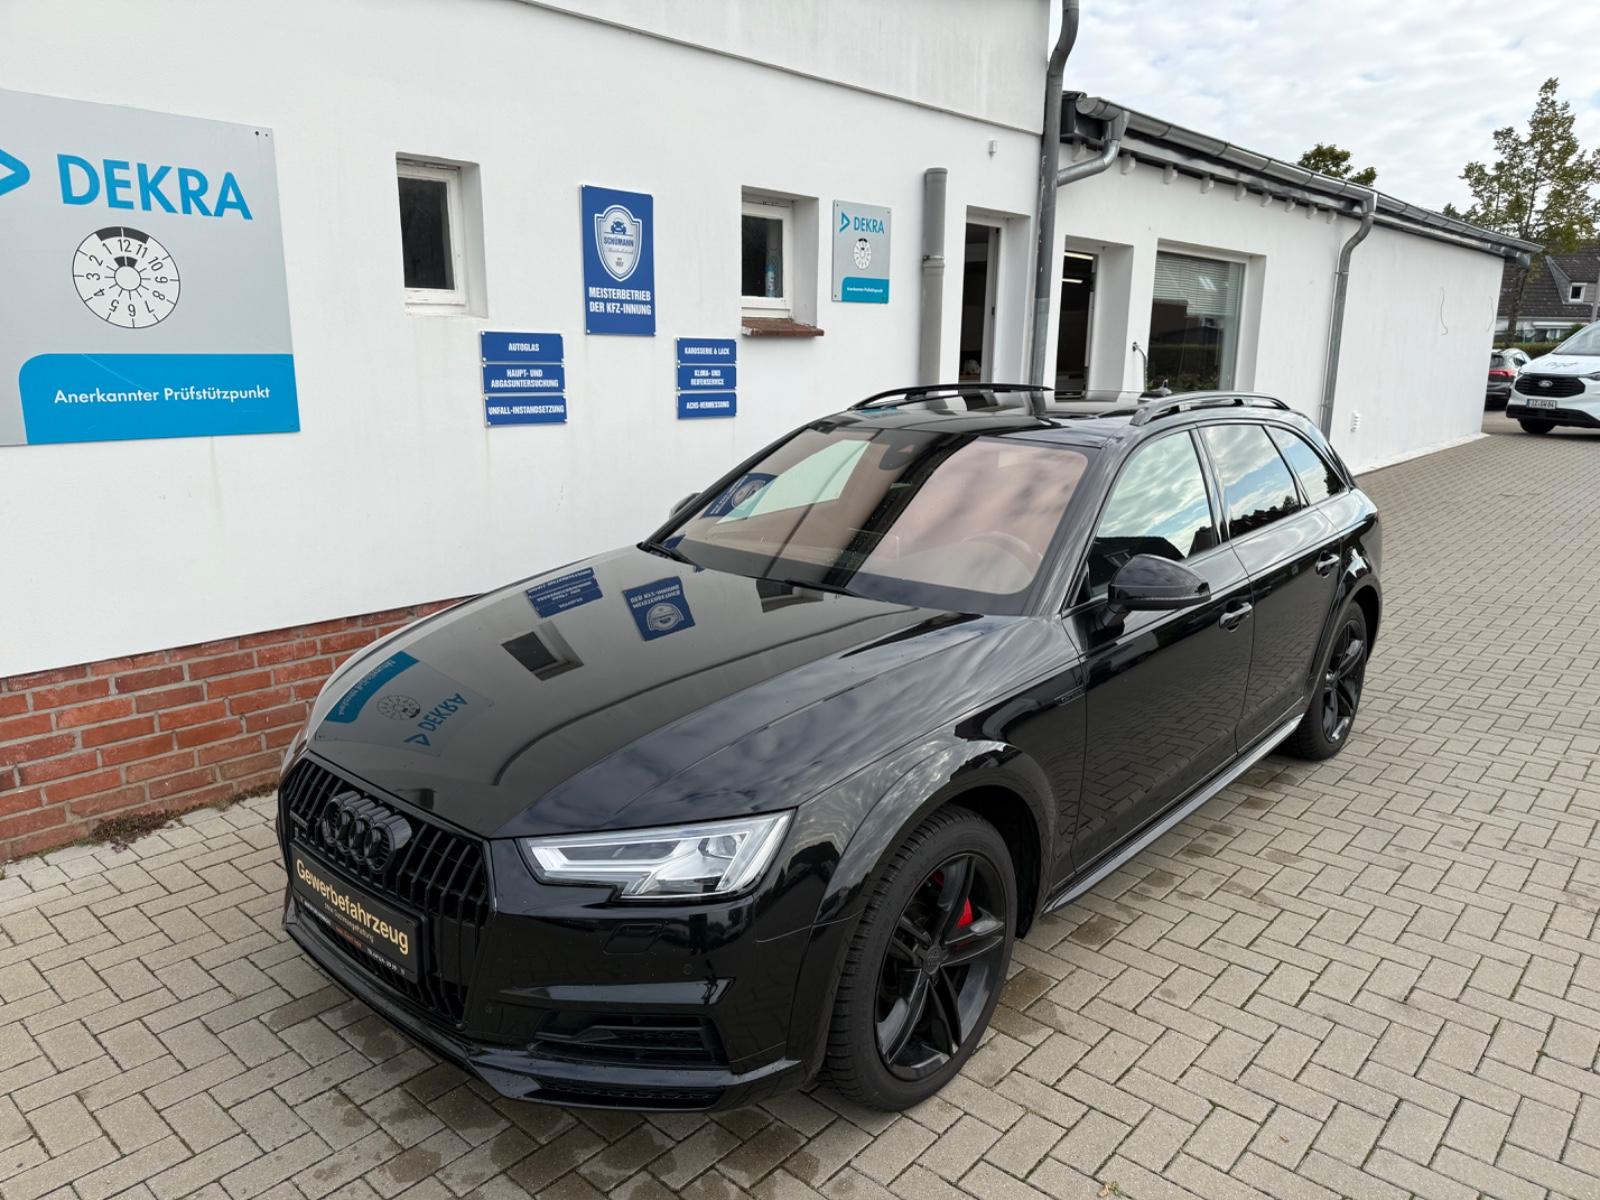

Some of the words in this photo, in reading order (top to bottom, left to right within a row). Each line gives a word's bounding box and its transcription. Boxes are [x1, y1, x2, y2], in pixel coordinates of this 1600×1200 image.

[57, 153, 253, 220] DEKRA
[854, 216, 885, 234] DEKRA
[102, 242, 112, 255] 1
[117, 238, 132, 252] 12
[136, 243, 148, 258] 11
[89, 254, 104, 266] 2
[148, 256, 164, 272] 10
[85, 272, 101, 281] 3
[93, 288, 105, 297] 4
[152, 290, 166, 301] 8
[588, 286, 652, 301] MEISTERBETRIEB
[108, 299, 120, 313] 5
[589, 301, 605, 313] DER
[606, 303, 652, 315] KFZ-INNUNG
[508, 342, 540, 352] AUTOGLAS
[506, 369, 529, 377] HAUPT-
[529, 369, 543, 377] UND
[491, 379, 559, 388] ABGASUNTERSUCHUNG
[54, 387, 159, 404] Anerkannter
[164, 385, 270, 403] Prüfstützpunkt
[488, 405, 565, 415] UNFALL-INSTANDSETZUNG
[296, 859, 409, 955] Gewerbefahrzeug
